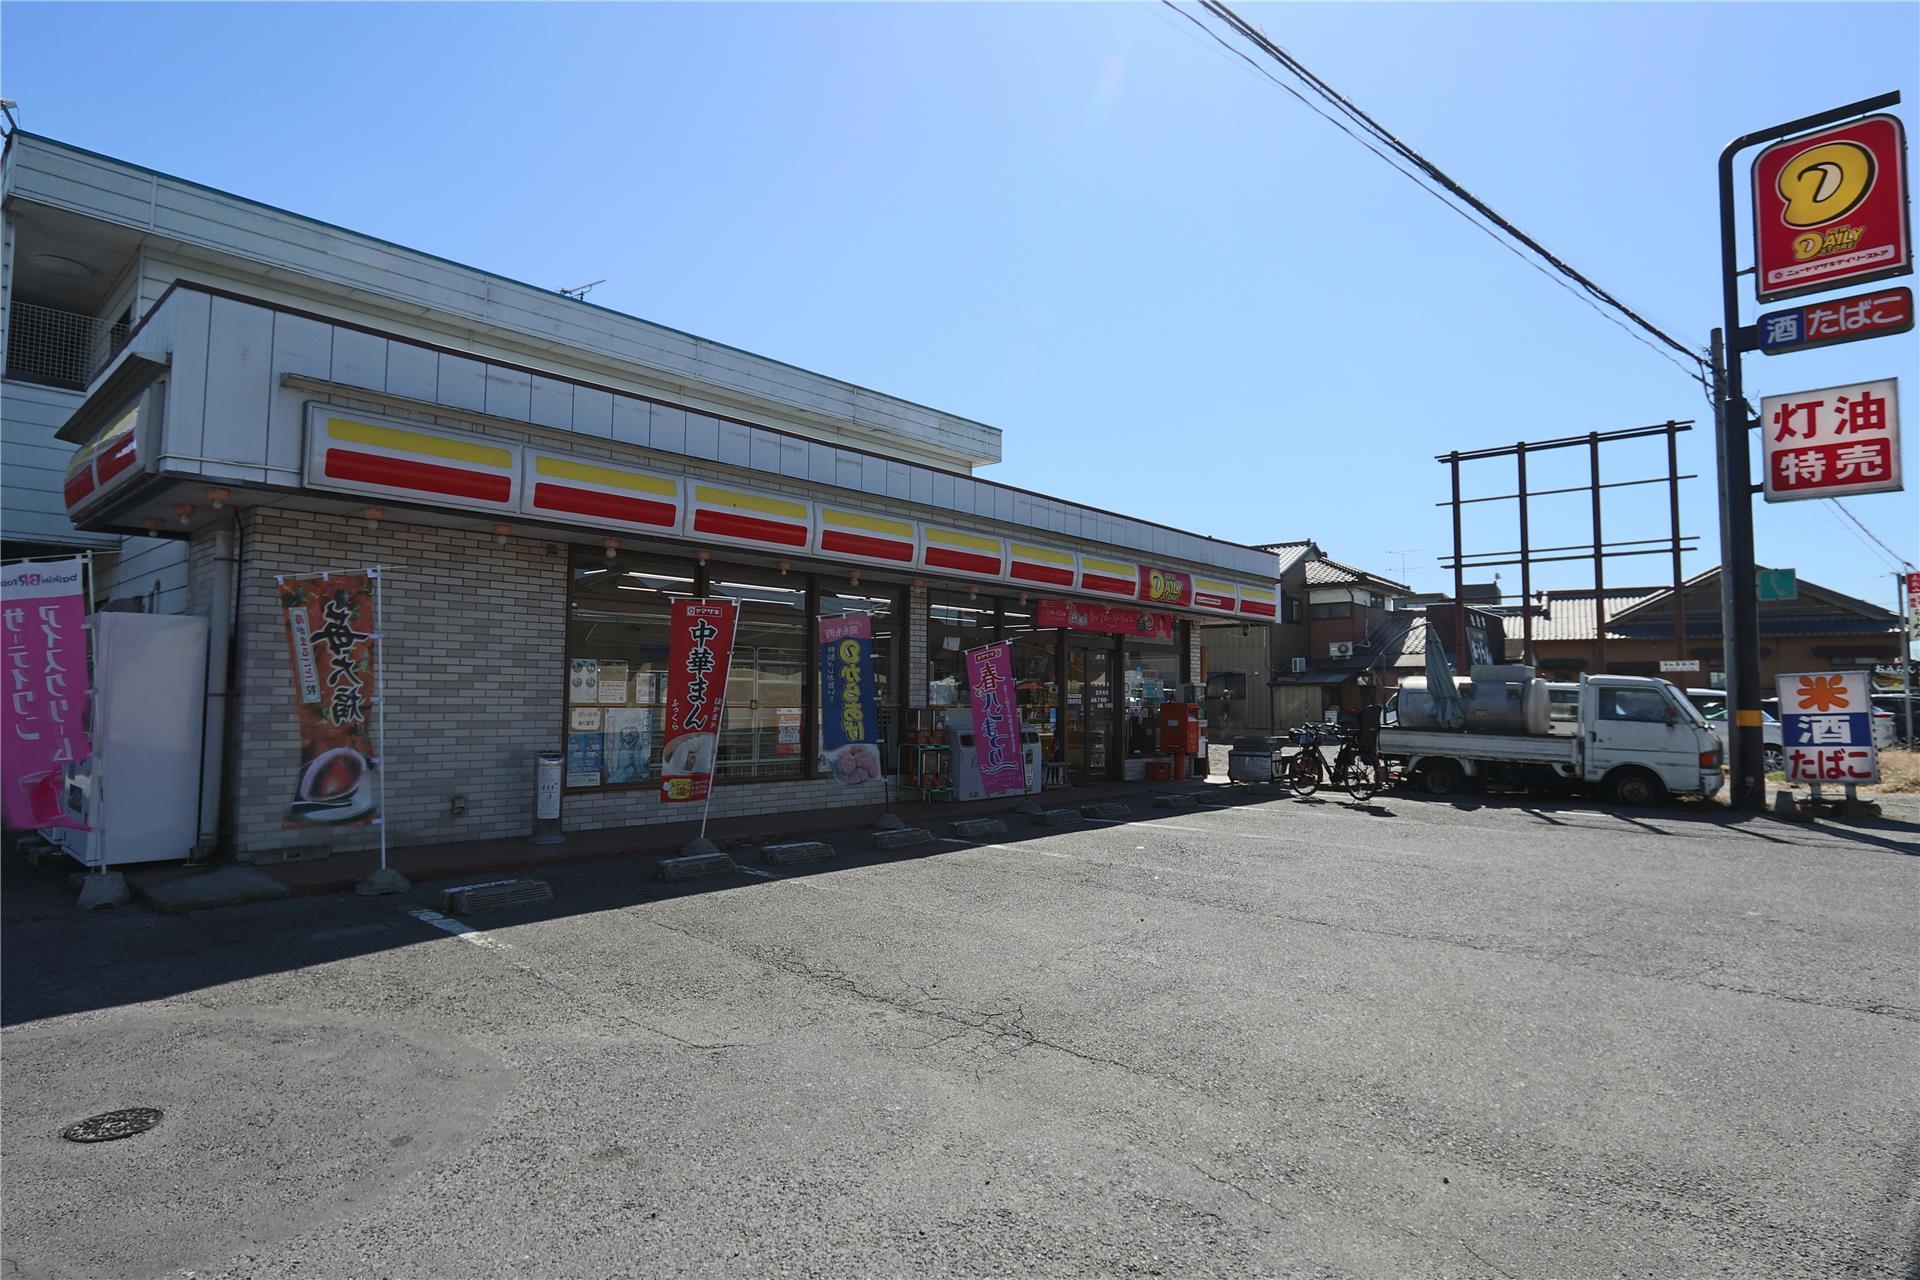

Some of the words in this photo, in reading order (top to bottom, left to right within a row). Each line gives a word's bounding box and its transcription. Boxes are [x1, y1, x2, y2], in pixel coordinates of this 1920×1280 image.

[1766, 313, 1799, 343] 酒
[1808, 295, 1903, 336] たばこ
[1773, 391, 1887, 443] 灯油
[1779, 444, 1884, 486] 特売
[682, 618, 719, 732] 中華まん
[1795, 673, 1850, 713] 米
[671, 698, 681, 731] ふっくら
[1797, 715, 1853, 745] 酒
[1788, 748, 1873, 780] たばこ
